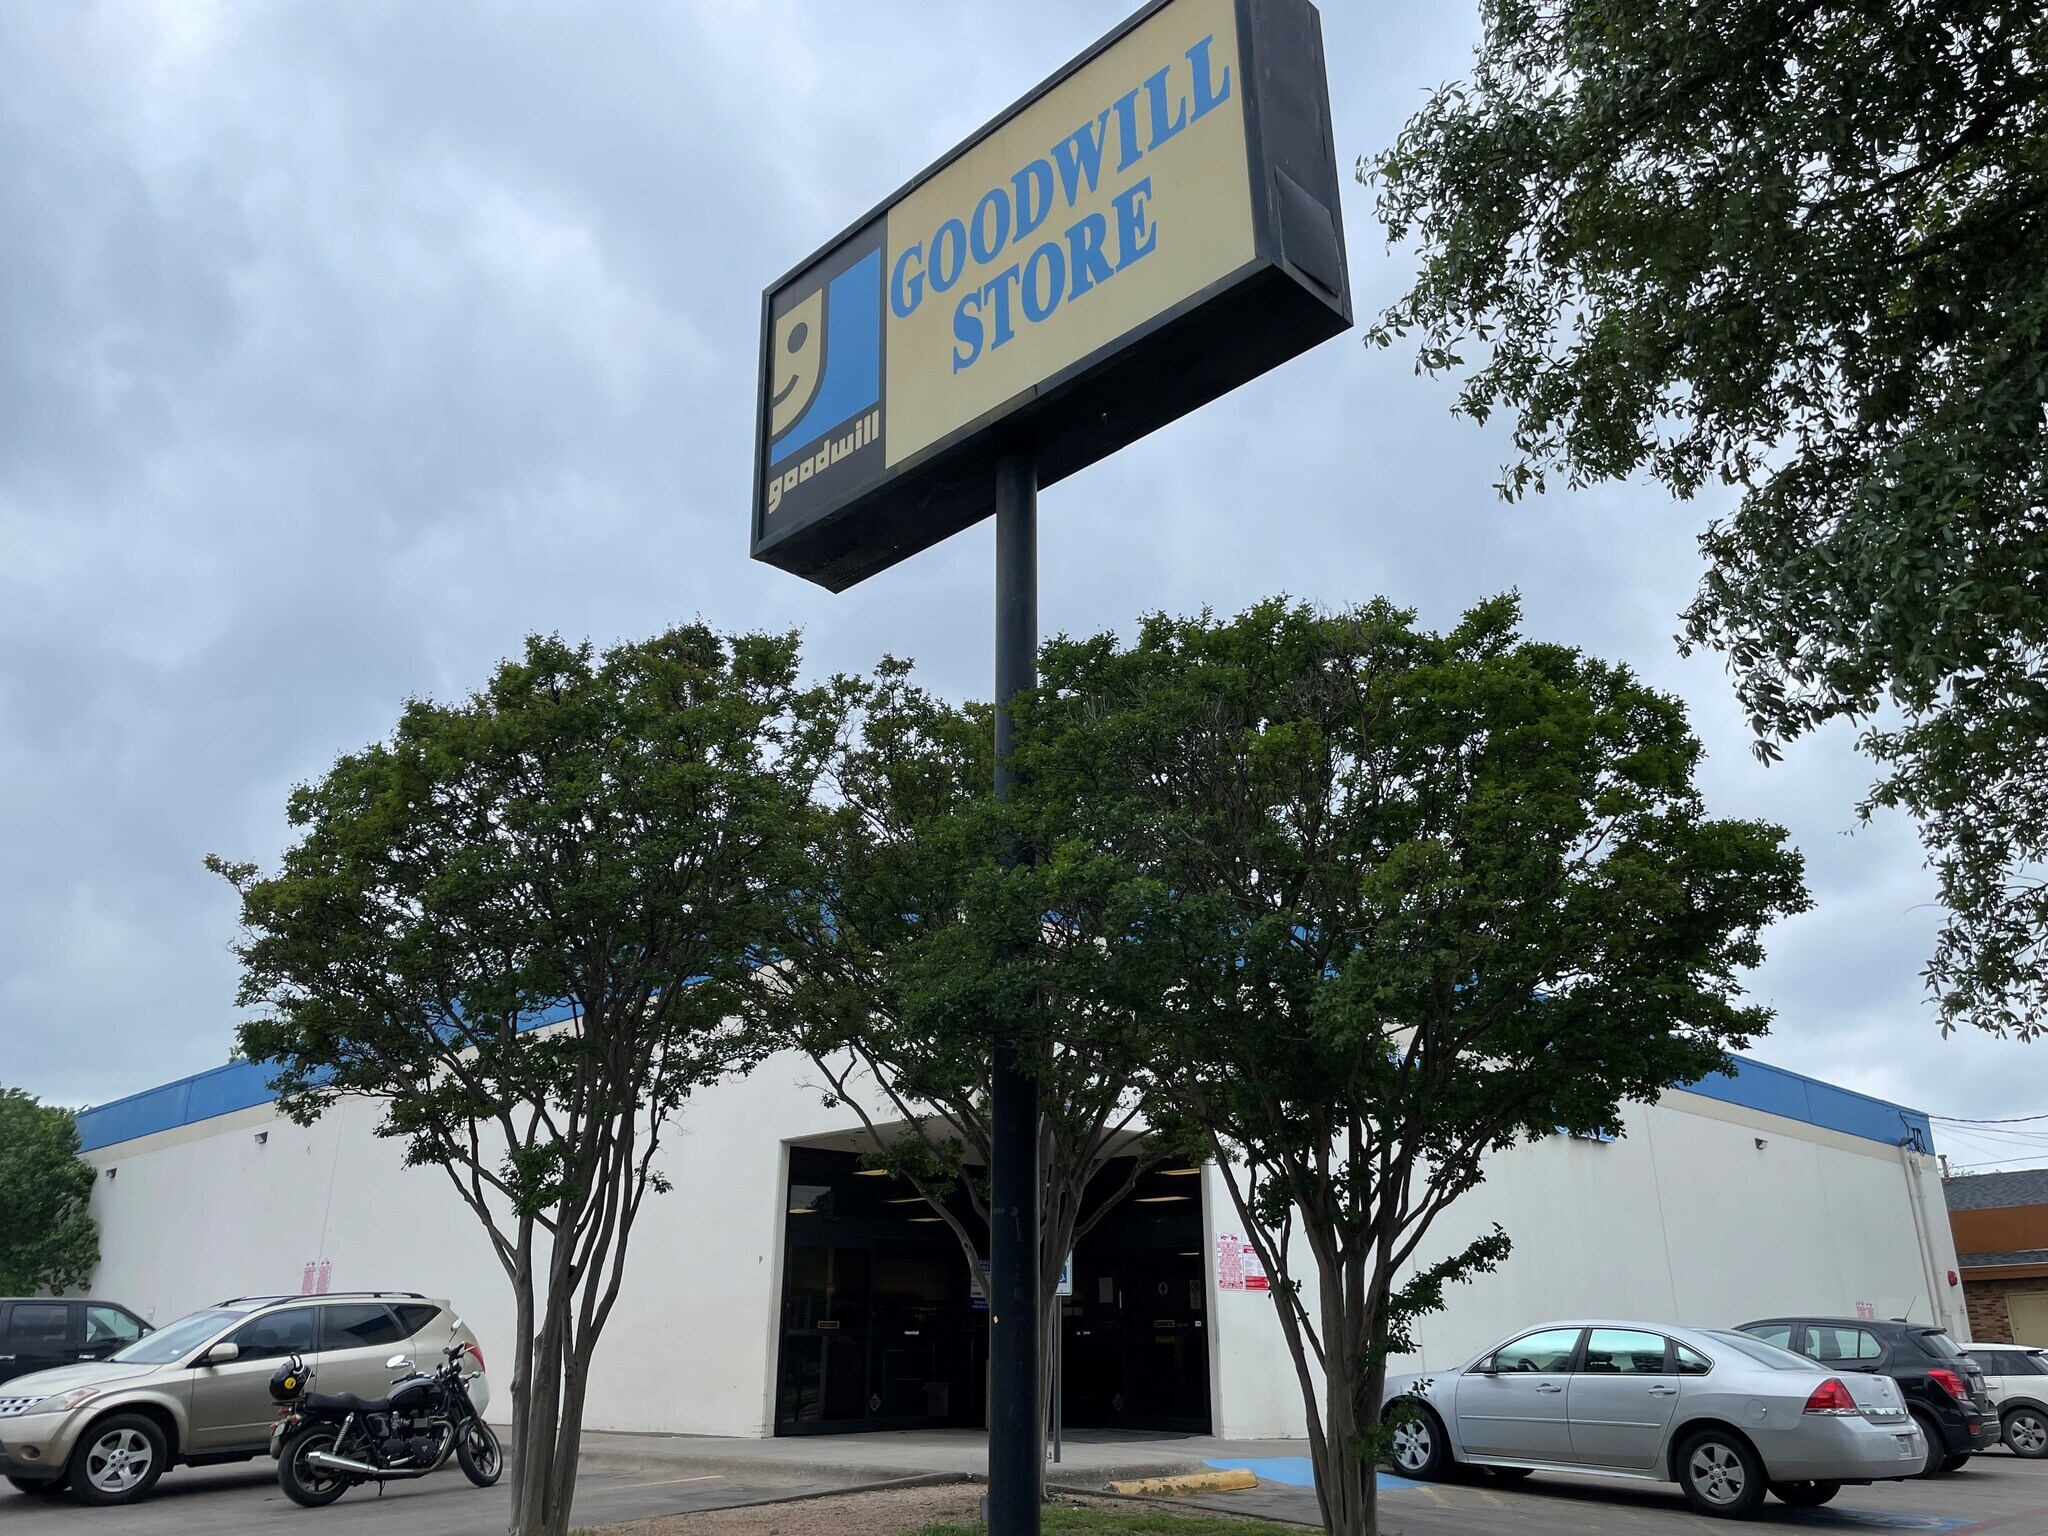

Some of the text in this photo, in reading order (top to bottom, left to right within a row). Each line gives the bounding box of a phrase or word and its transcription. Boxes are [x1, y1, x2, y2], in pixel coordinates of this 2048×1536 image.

[890, 34, 1231, 318] GOODWILL
[953, 176, 1157, 375] STORE
[768, 409, 880, 515] goodwill
